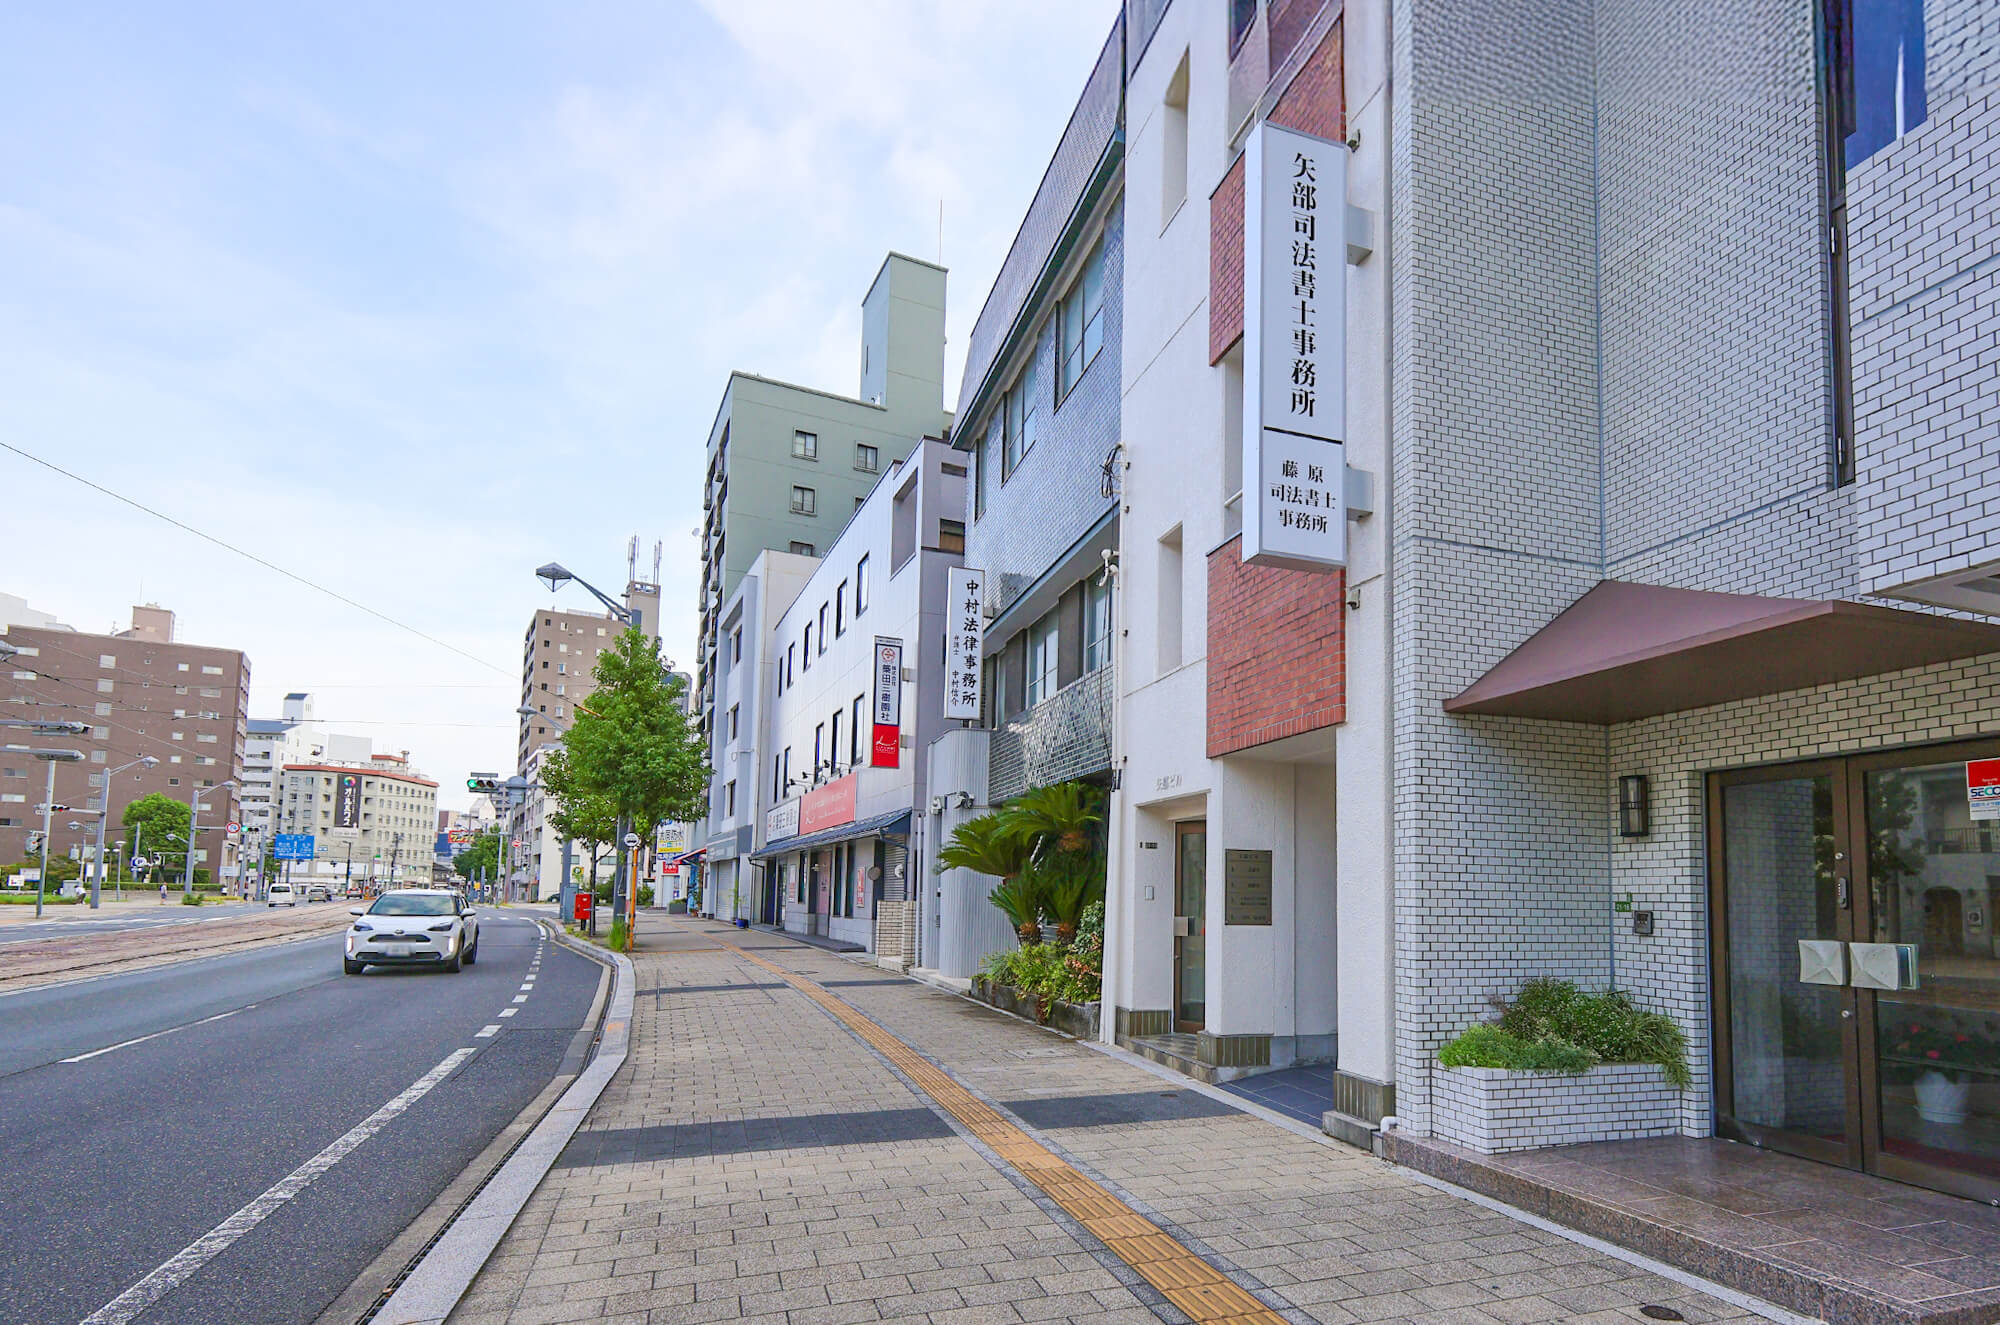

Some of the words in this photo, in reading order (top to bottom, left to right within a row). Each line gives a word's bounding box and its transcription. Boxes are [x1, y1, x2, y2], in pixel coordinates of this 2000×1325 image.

[1291, 152, 1317, 417] 矢部司法書士事務所
[1271, 484, 1336, 510] 司法書士
[1279, 509, 1327, 533] 事務所
[962, 579, 980, 707] 中村法律事務所
